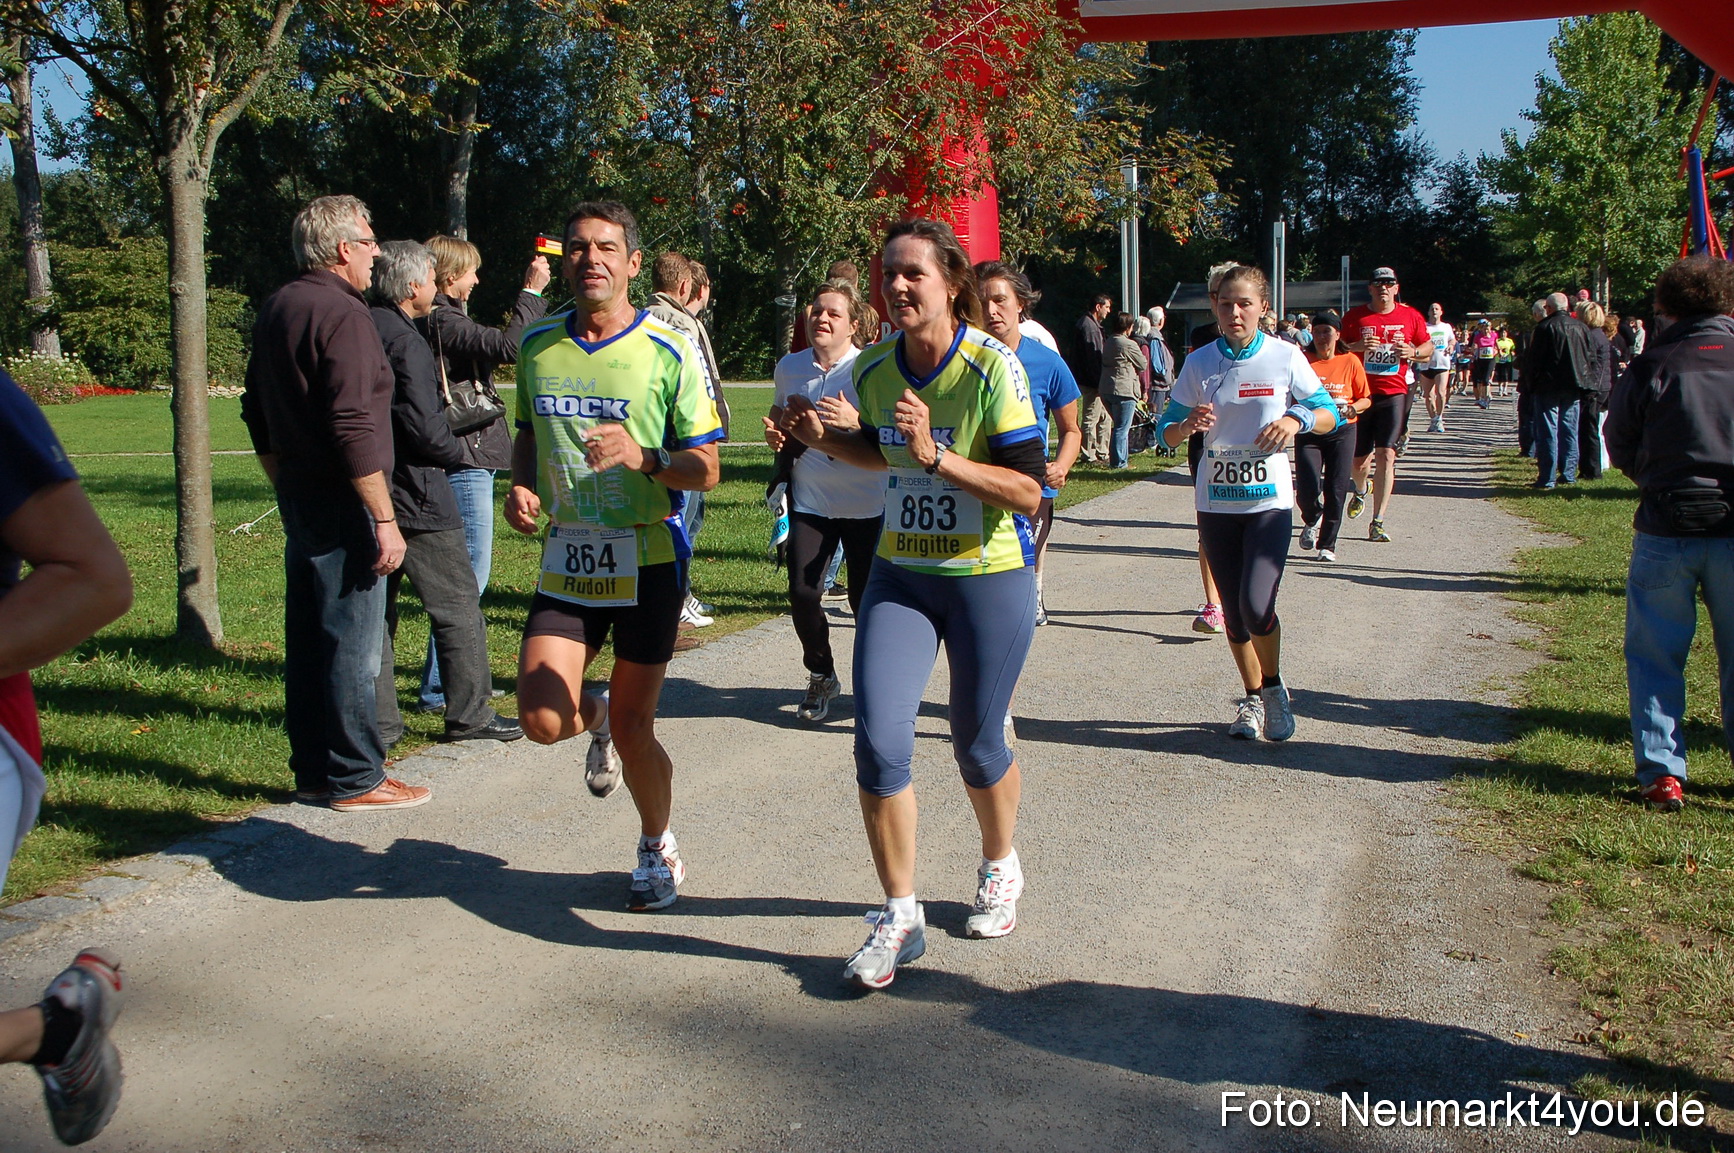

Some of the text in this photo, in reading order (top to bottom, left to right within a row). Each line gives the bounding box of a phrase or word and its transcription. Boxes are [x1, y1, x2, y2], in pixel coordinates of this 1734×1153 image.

[1367, 351, 1397, 364] 2925
[535, 376, 596, 392] TEAM
[534, 395, 630, 420] BOCK
[878, 426, 955, 447] BOK
[1213, 460, 1267, 484] 2686
[1212, 485, 1270, 498] Katharina
[900, 494, 957, 531] 863
[896, 533, 960, 557] Brigitte
[565, 543, 617, 574] 864
[563, 576, 617, 595] Rudolf
